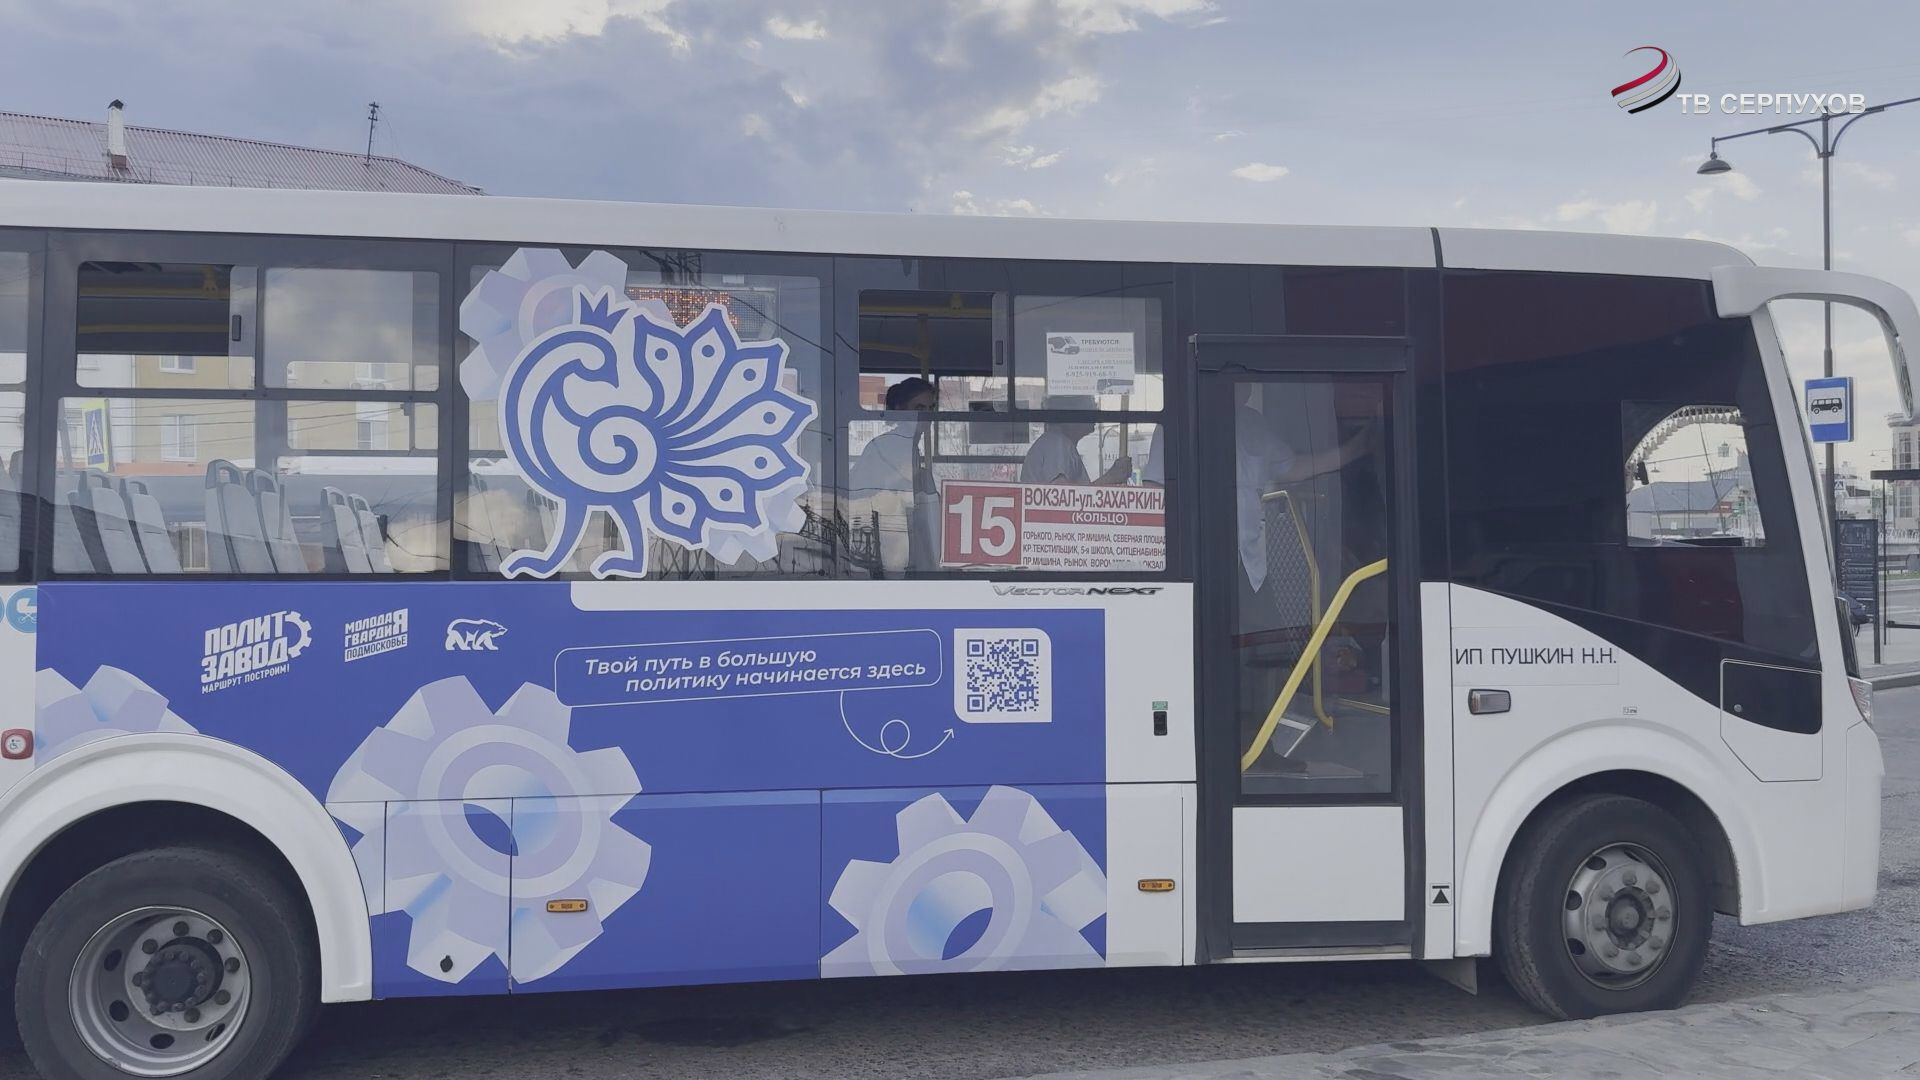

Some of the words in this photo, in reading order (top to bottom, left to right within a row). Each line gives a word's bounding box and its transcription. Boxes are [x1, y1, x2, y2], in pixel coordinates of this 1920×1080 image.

[949, 495, 1016, 557] 15
[1071, 512, 1129, 526] (КОЛЬЦО)
[1113, 534, 1143, 544] СЕВЕРНАЯ
[204, 610, 287, 656] ПОЛИТ
[201, 636, 290, 684] ЗАВОД
[346, 635, 407, 661] ПОДМОСКОВЬЕ
[585, 656, 637, 675] Твой
[644, 657, 692, 675] путь
[699, 655, 711, 668] в
[717, 649, 817, 670] большую
[1455, 648, 1483, 664] ИП
[1491, 648, 1573, 664] ПУШКИН
[1582, 647, 1617, 664] Н.Н.
[201, 676, 242, 694] МАРШРУТ
[244, 664, 290, 683] ПОСТРОИМ!
[625, 674, 729, 693] политику
[736, 667, 860, 686] начинается
[867, 662, 926, 679] здесь
